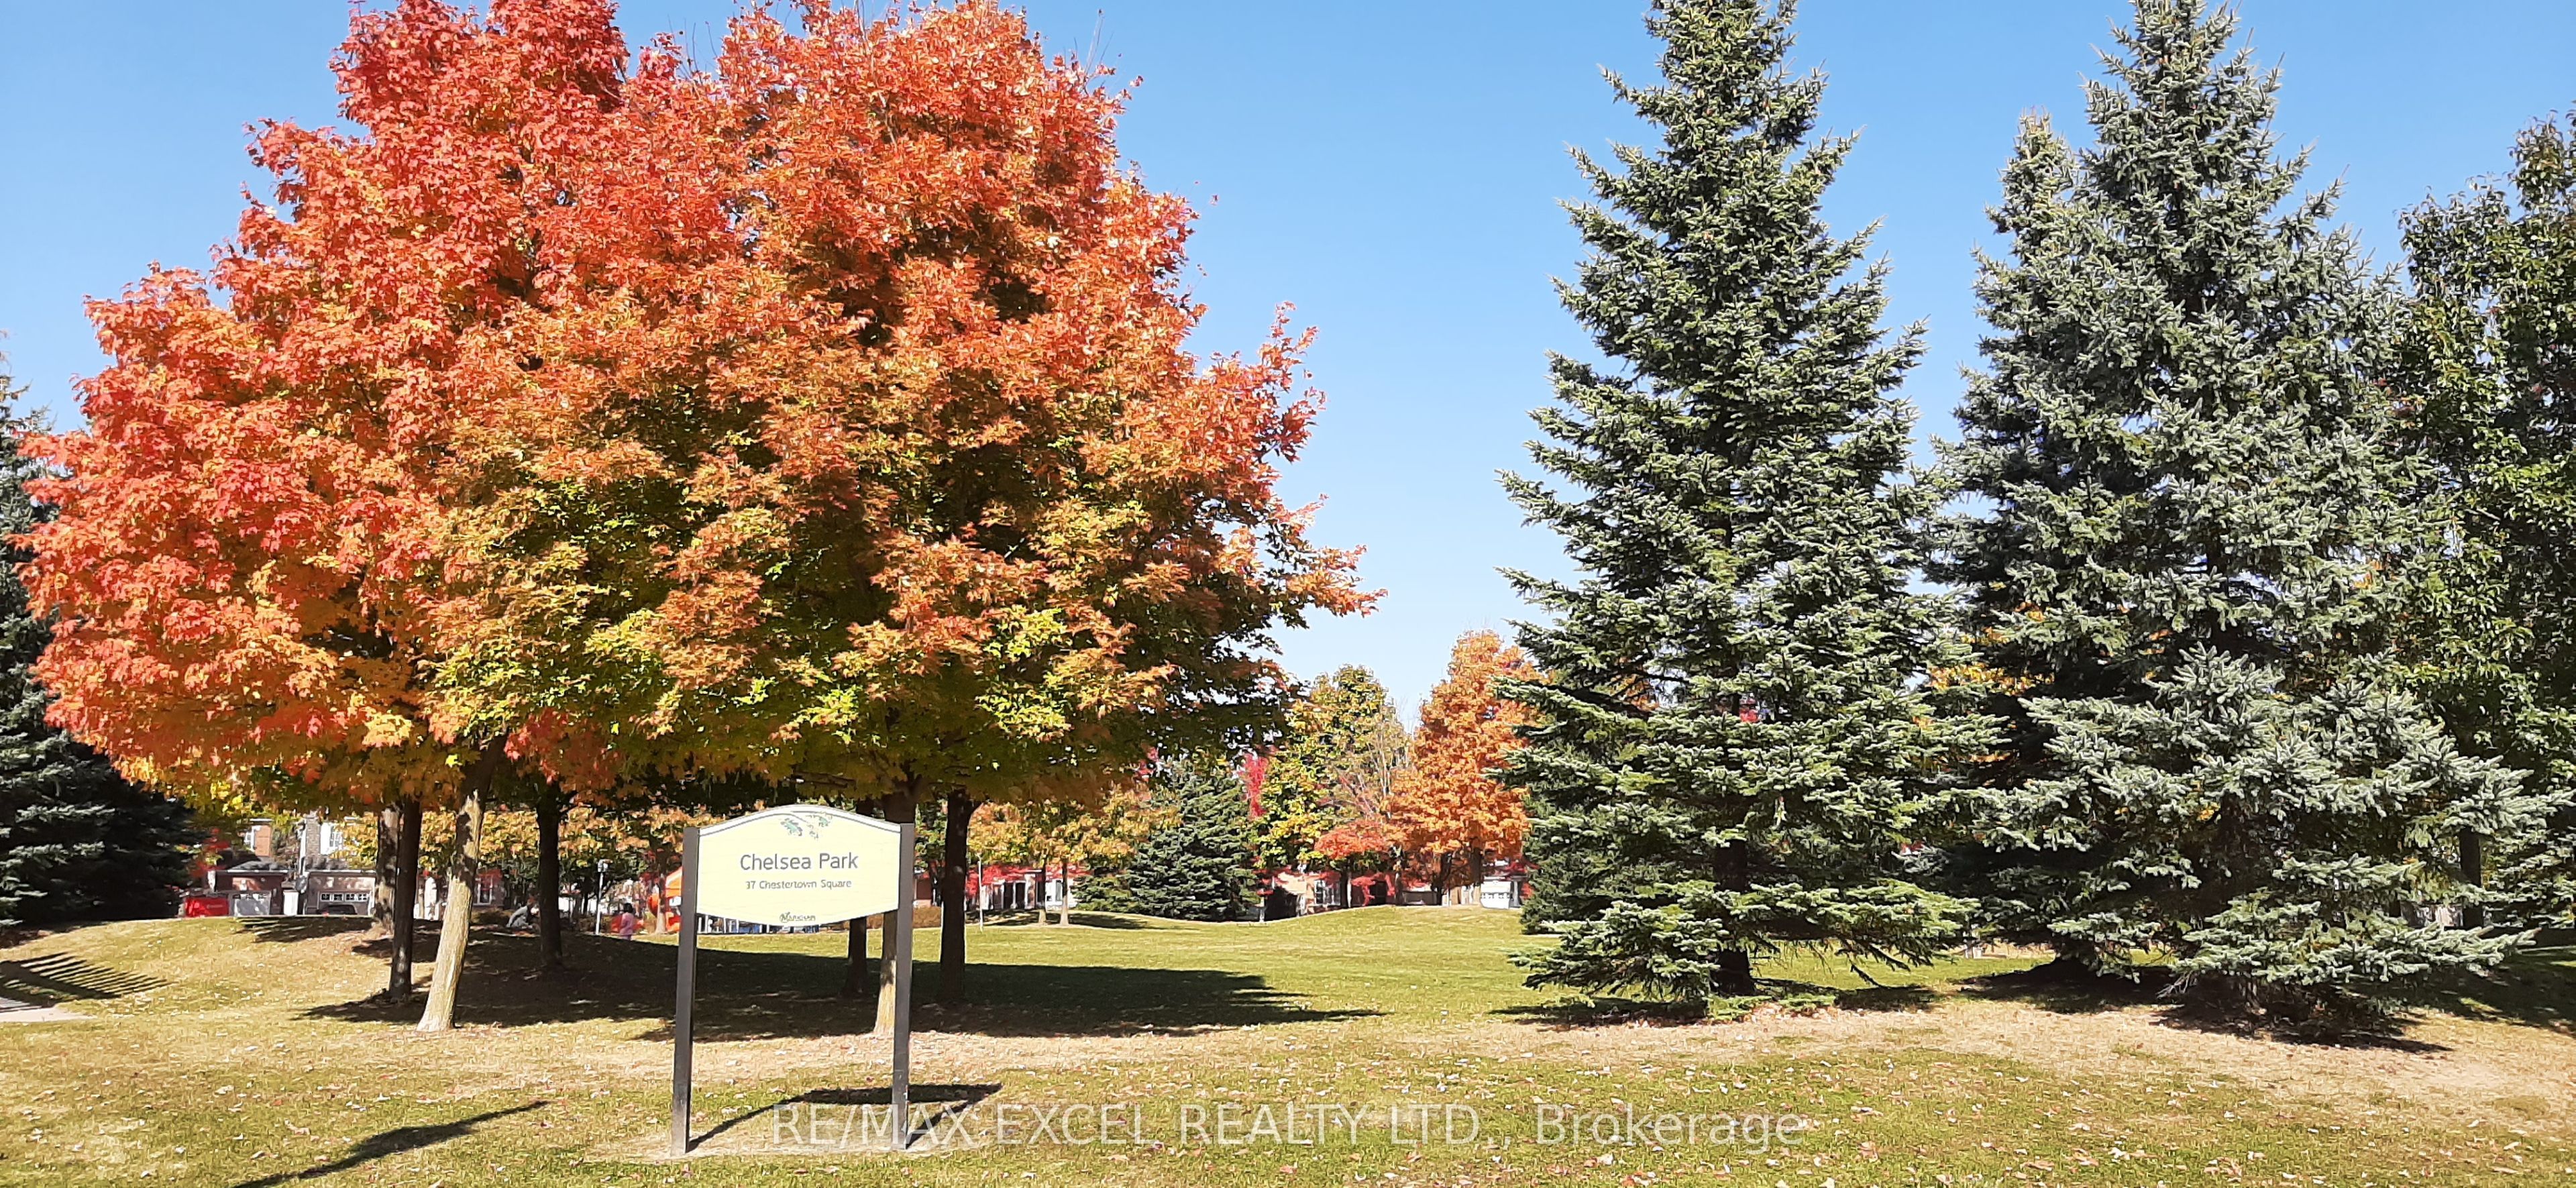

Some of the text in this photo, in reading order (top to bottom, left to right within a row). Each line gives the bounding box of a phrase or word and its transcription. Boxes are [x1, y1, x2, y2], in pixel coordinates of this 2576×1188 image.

[740, 852, 859, 871] Chelsea Park
[745, 881, 756, 889] 37
[820, 879, 852, 890] Square
